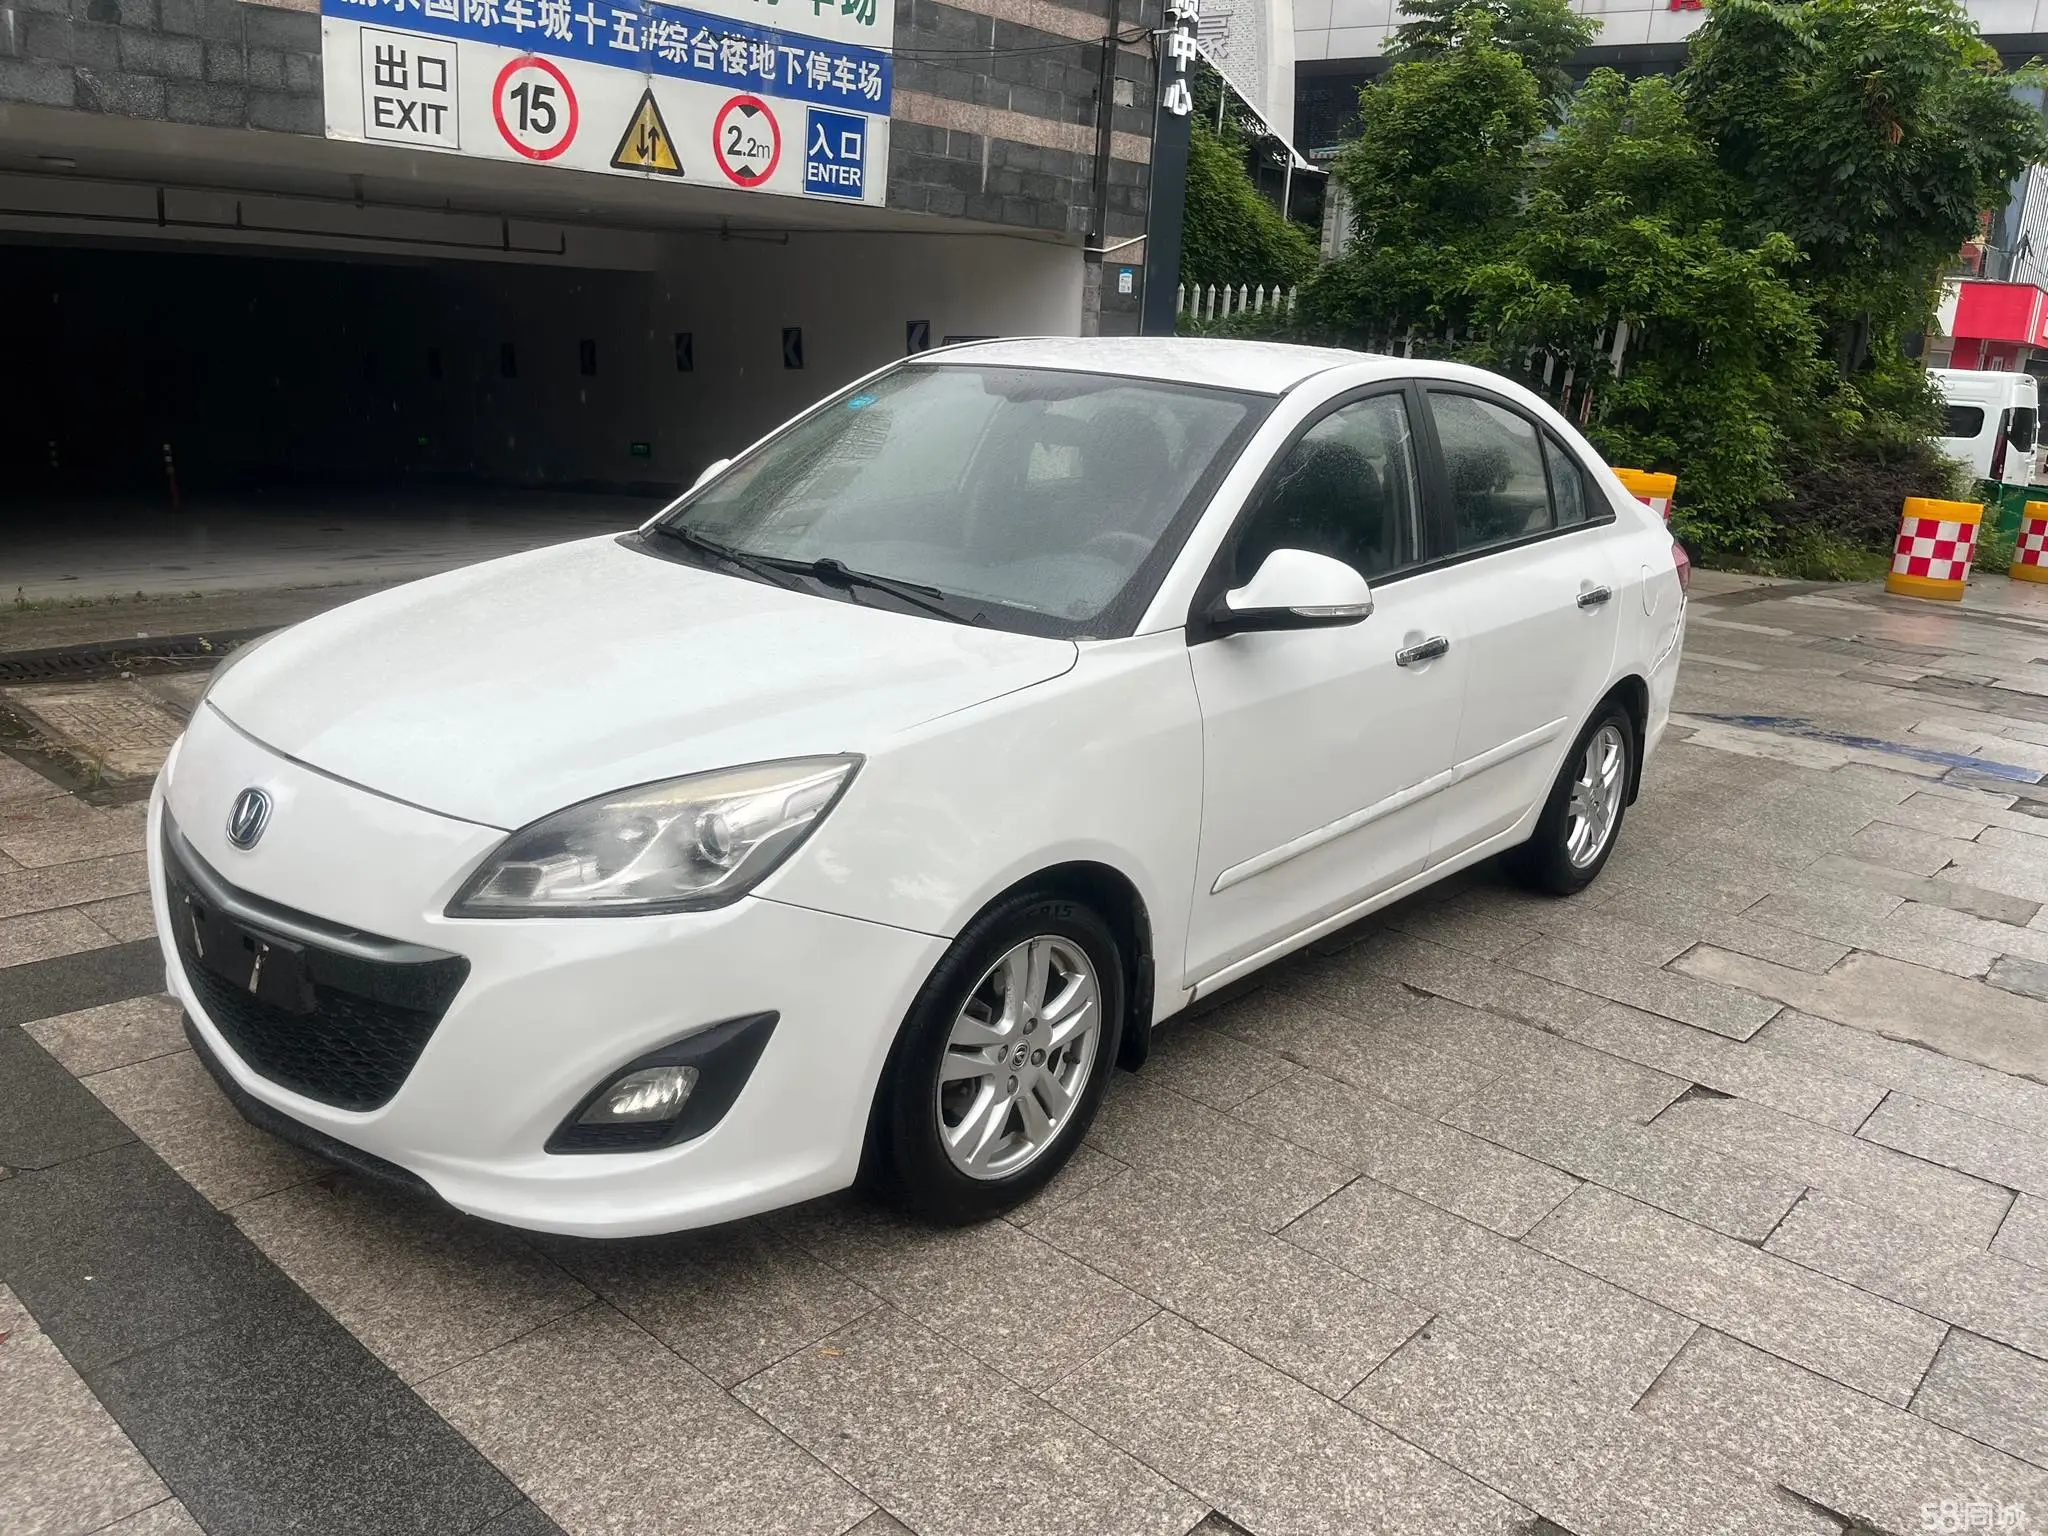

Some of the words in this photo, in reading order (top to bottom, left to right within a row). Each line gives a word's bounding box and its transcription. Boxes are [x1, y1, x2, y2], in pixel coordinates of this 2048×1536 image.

[375, 45, 447, 92] 出口
[374, 96, 448, 135] EXIT
[510, 81, 557, 134] 15
[727, 125, 770, 159] 2.2m
[809, 122, 862, 161] 入口
[807, 161, 861, 187] ENTER
